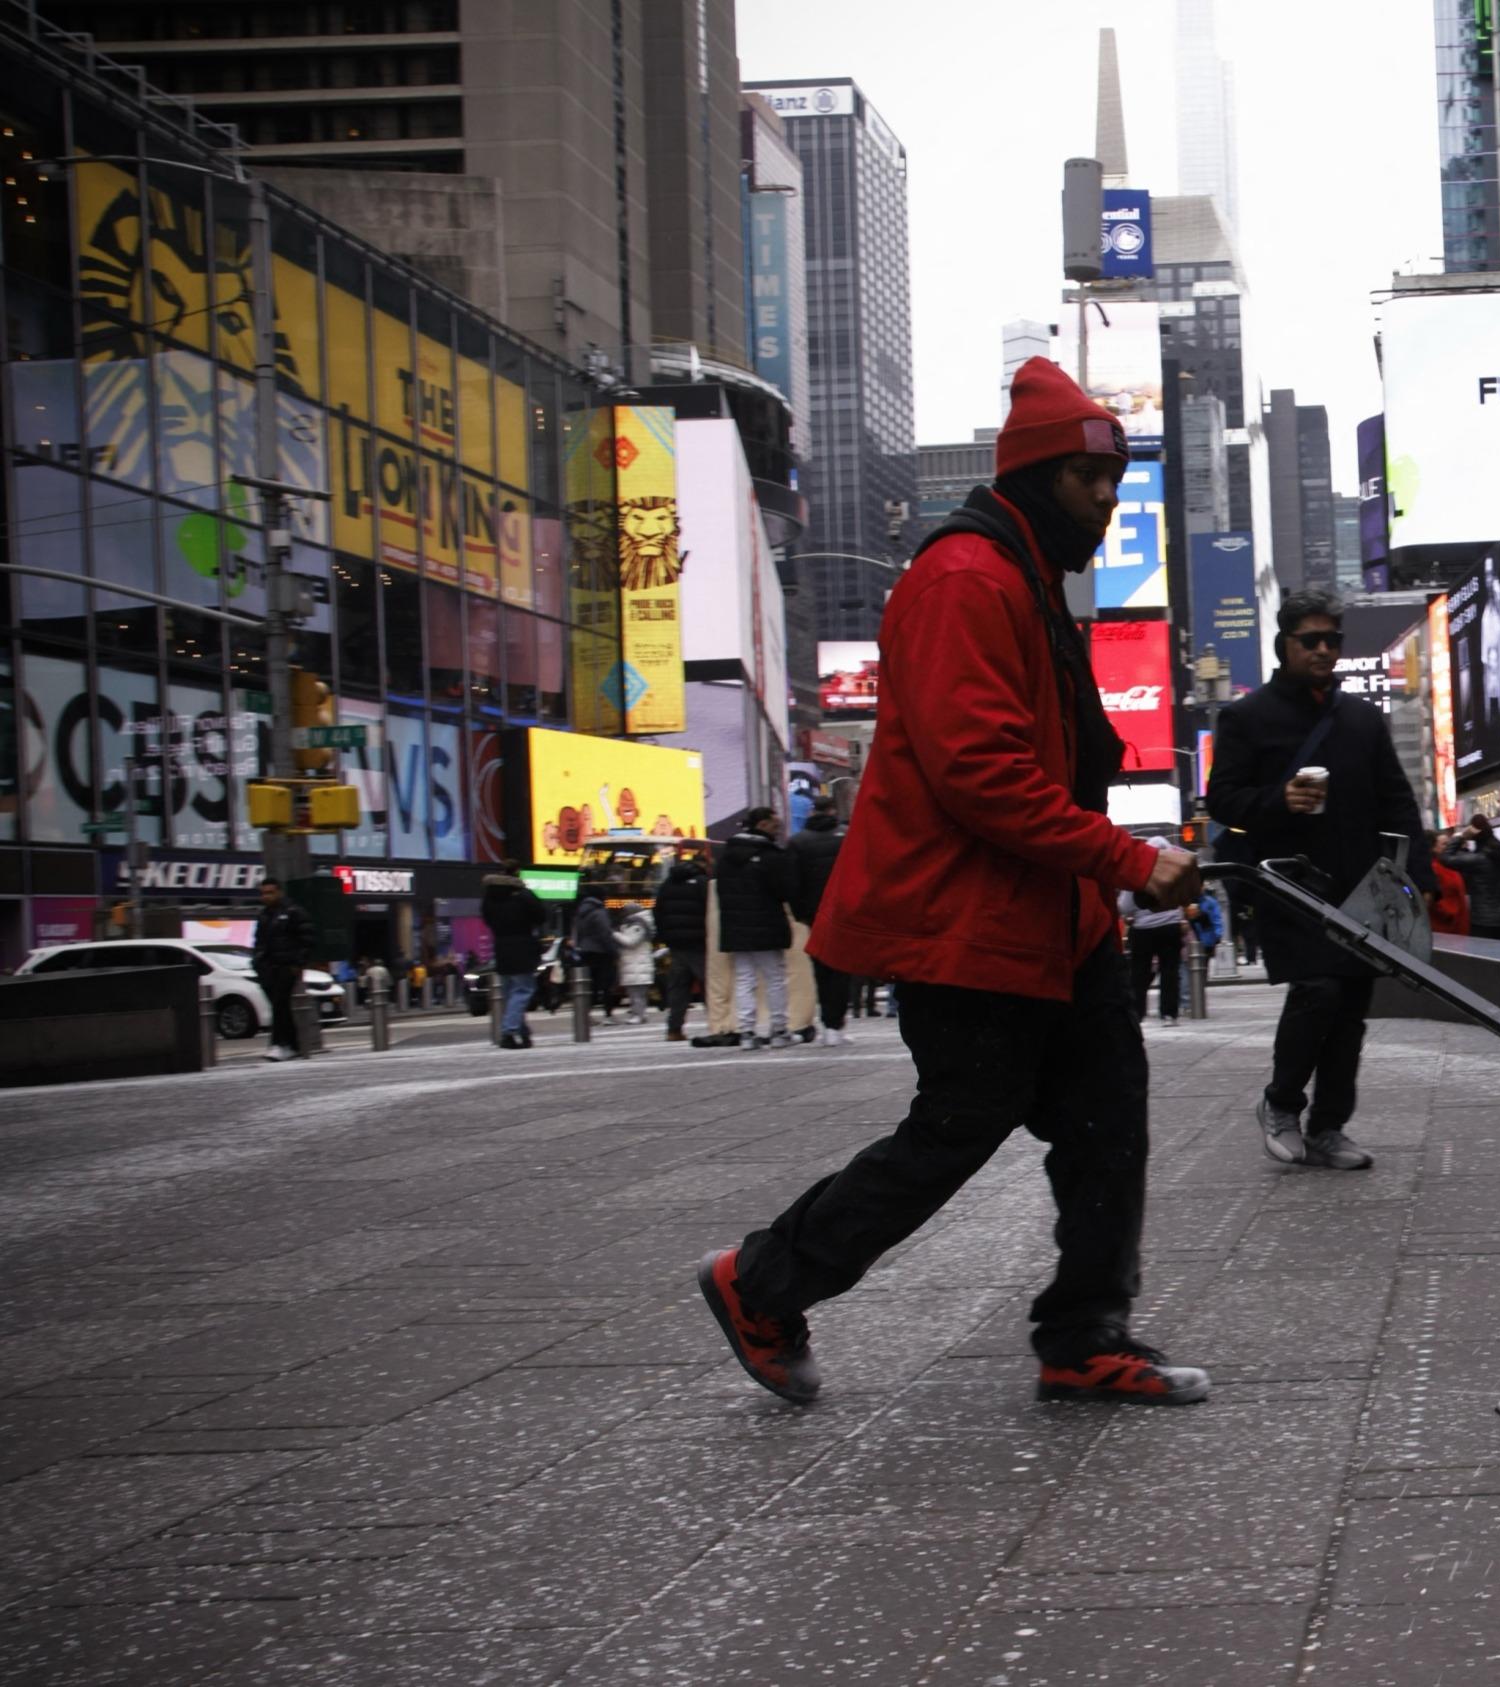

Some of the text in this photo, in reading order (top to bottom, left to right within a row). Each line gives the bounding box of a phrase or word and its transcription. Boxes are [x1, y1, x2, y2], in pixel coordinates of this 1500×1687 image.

[755, 213, 780, 359] TIMES
[397, 367, 455, 436] THE
[340, 403, 522, 551] LION KING
[352, 870, 414, 892] TISSOT
